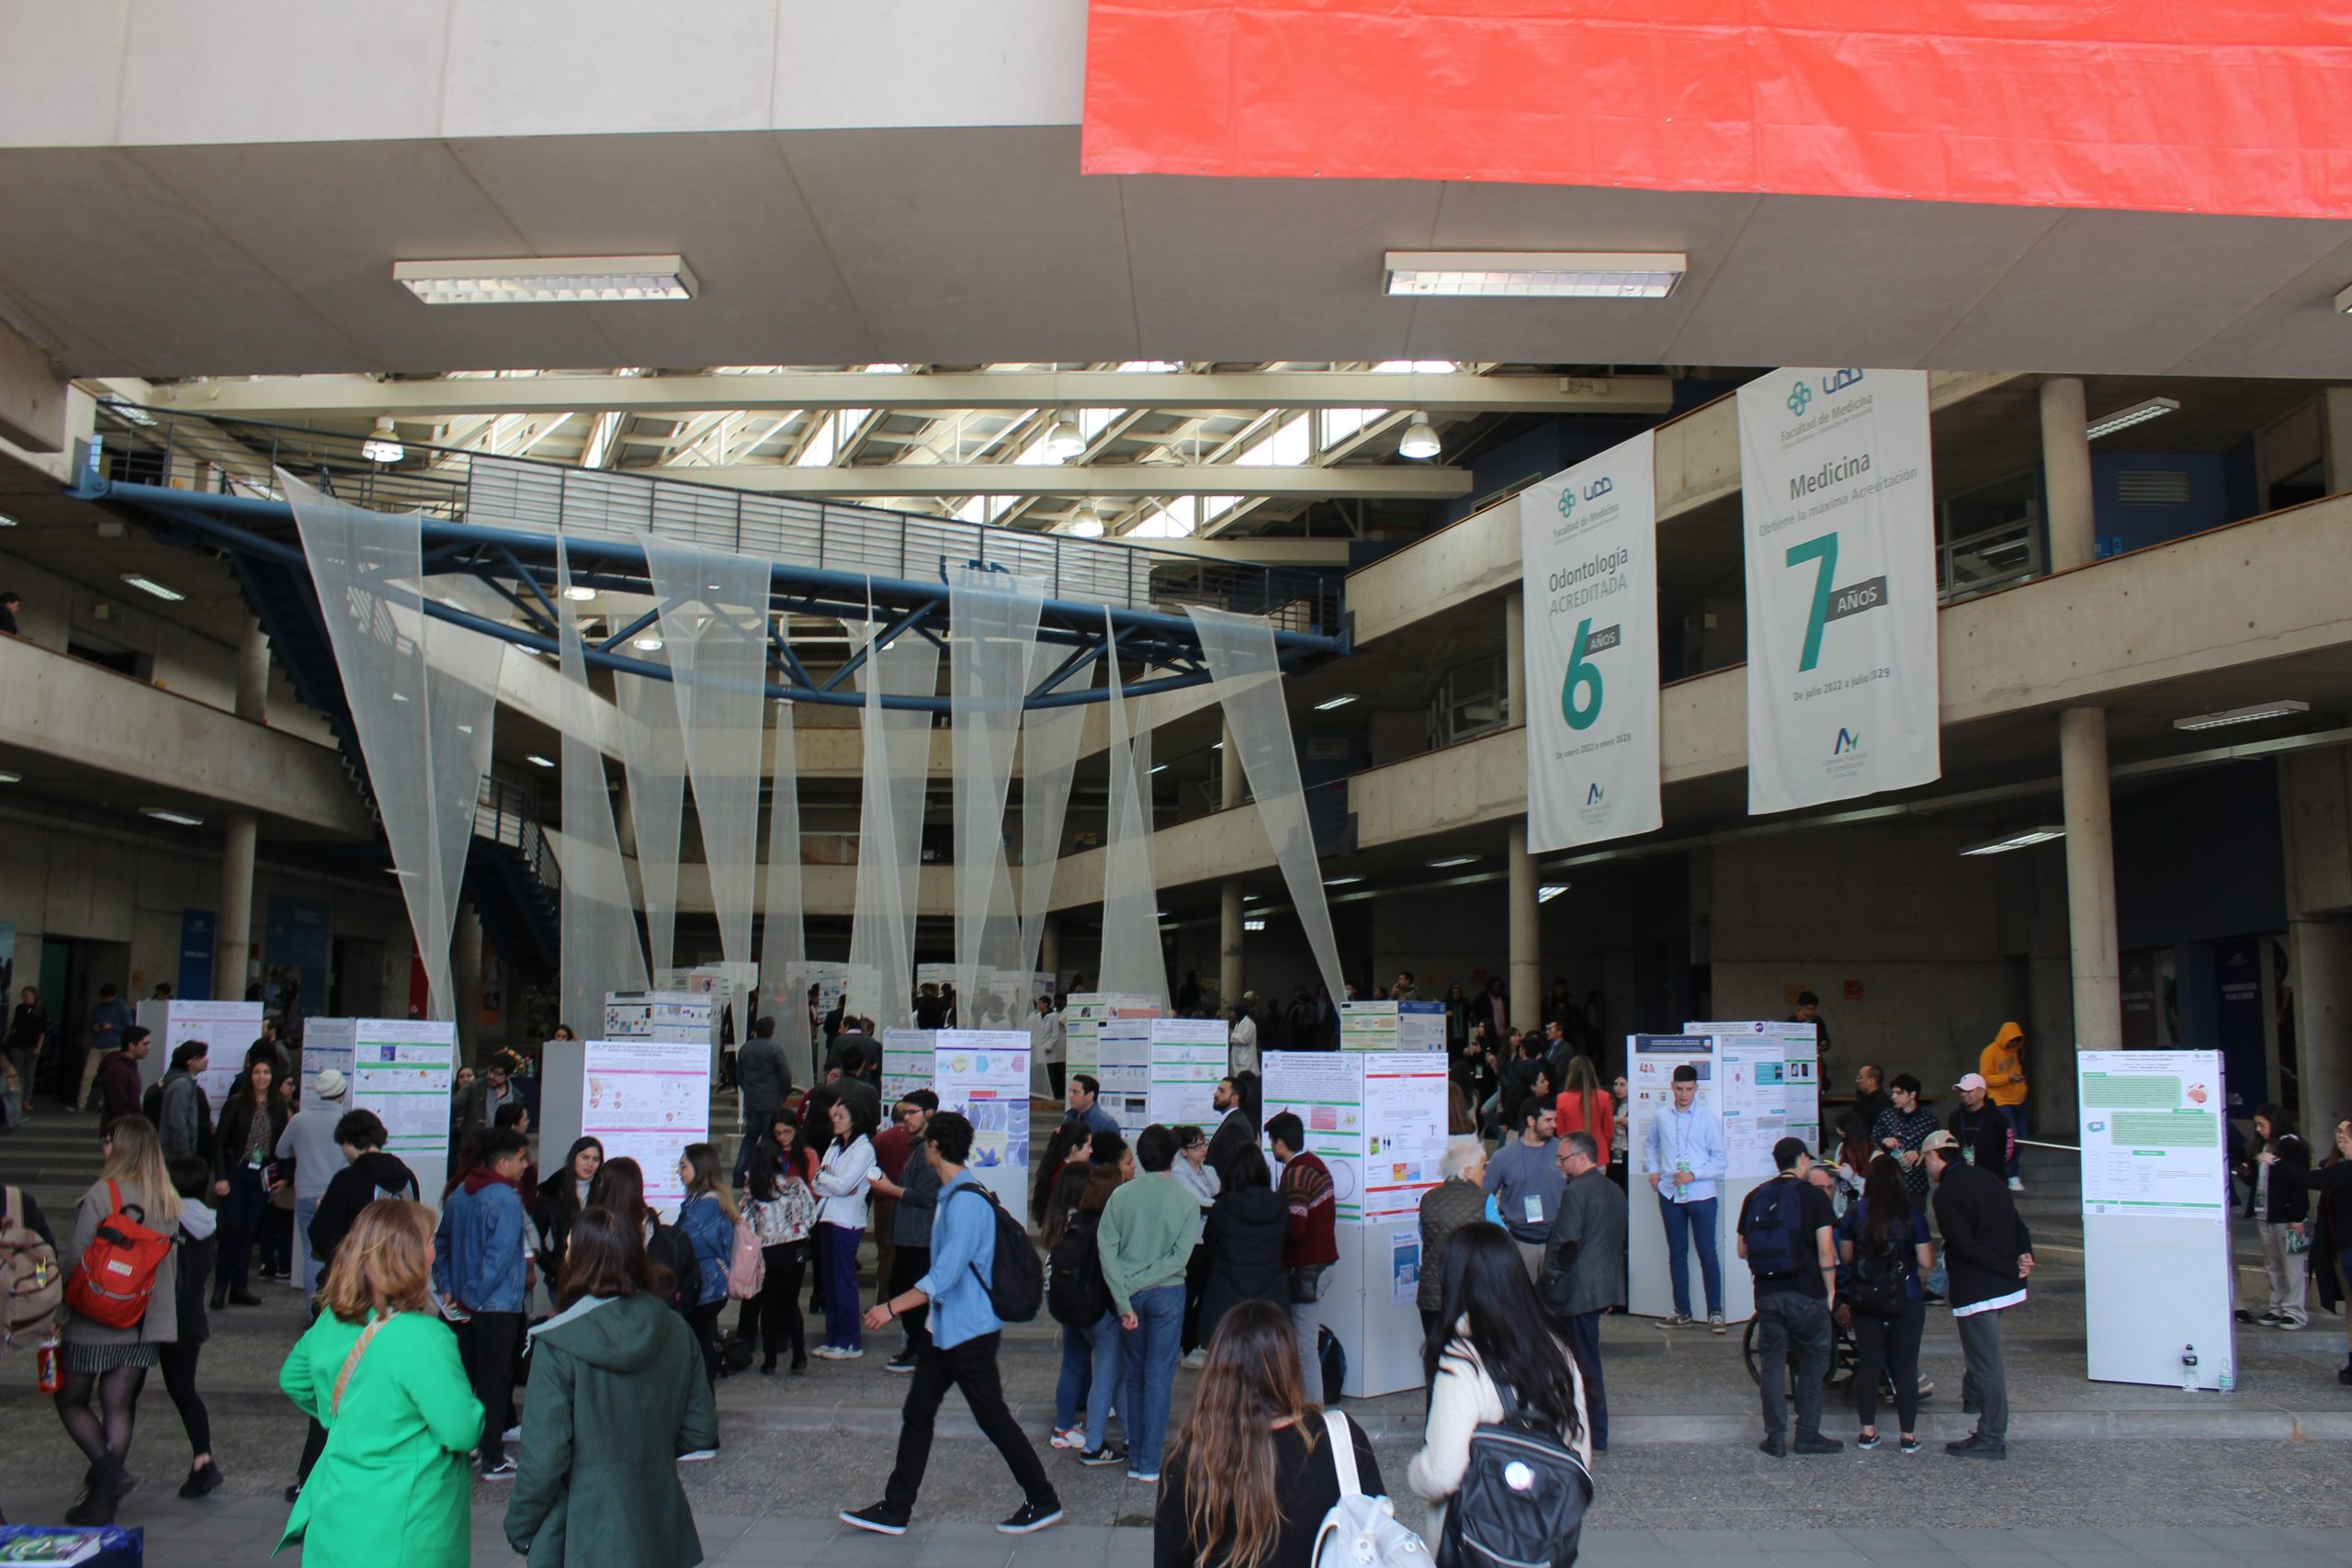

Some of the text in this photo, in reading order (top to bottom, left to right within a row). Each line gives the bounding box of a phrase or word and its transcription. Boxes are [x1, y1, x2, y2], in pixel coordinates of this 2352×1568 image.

[1781, 416, 1816, 443] Facultad
[1818, 412, 1830, 425] de
[1832, 394, 1873, 420] Medicina
[1583, 477, 1612, 502] UDD
[1790, 453, 1871, 501] Medicina
[1580, 515, 1589, 526] de
[1589, 502, 1620, 523] Medicina
[1758, 468, 1917, 537] Obtiene la máxima Acreditación
[1549, 546, 1628, 592] Odontología
[1549, 572, 1628, 617] ACREDITADA
[1786, 531, 1838, 673] 7
[1837, 586, 1878, 614] AÑOS
[1589, 631, 1617, 651] AÑOS
[1561, 617, 1603, 730] 6
[1793, 692, 1804, 702] De
[1824, 680, 1842, 694] 2022
[1850, 674, 1869, 690] julio
